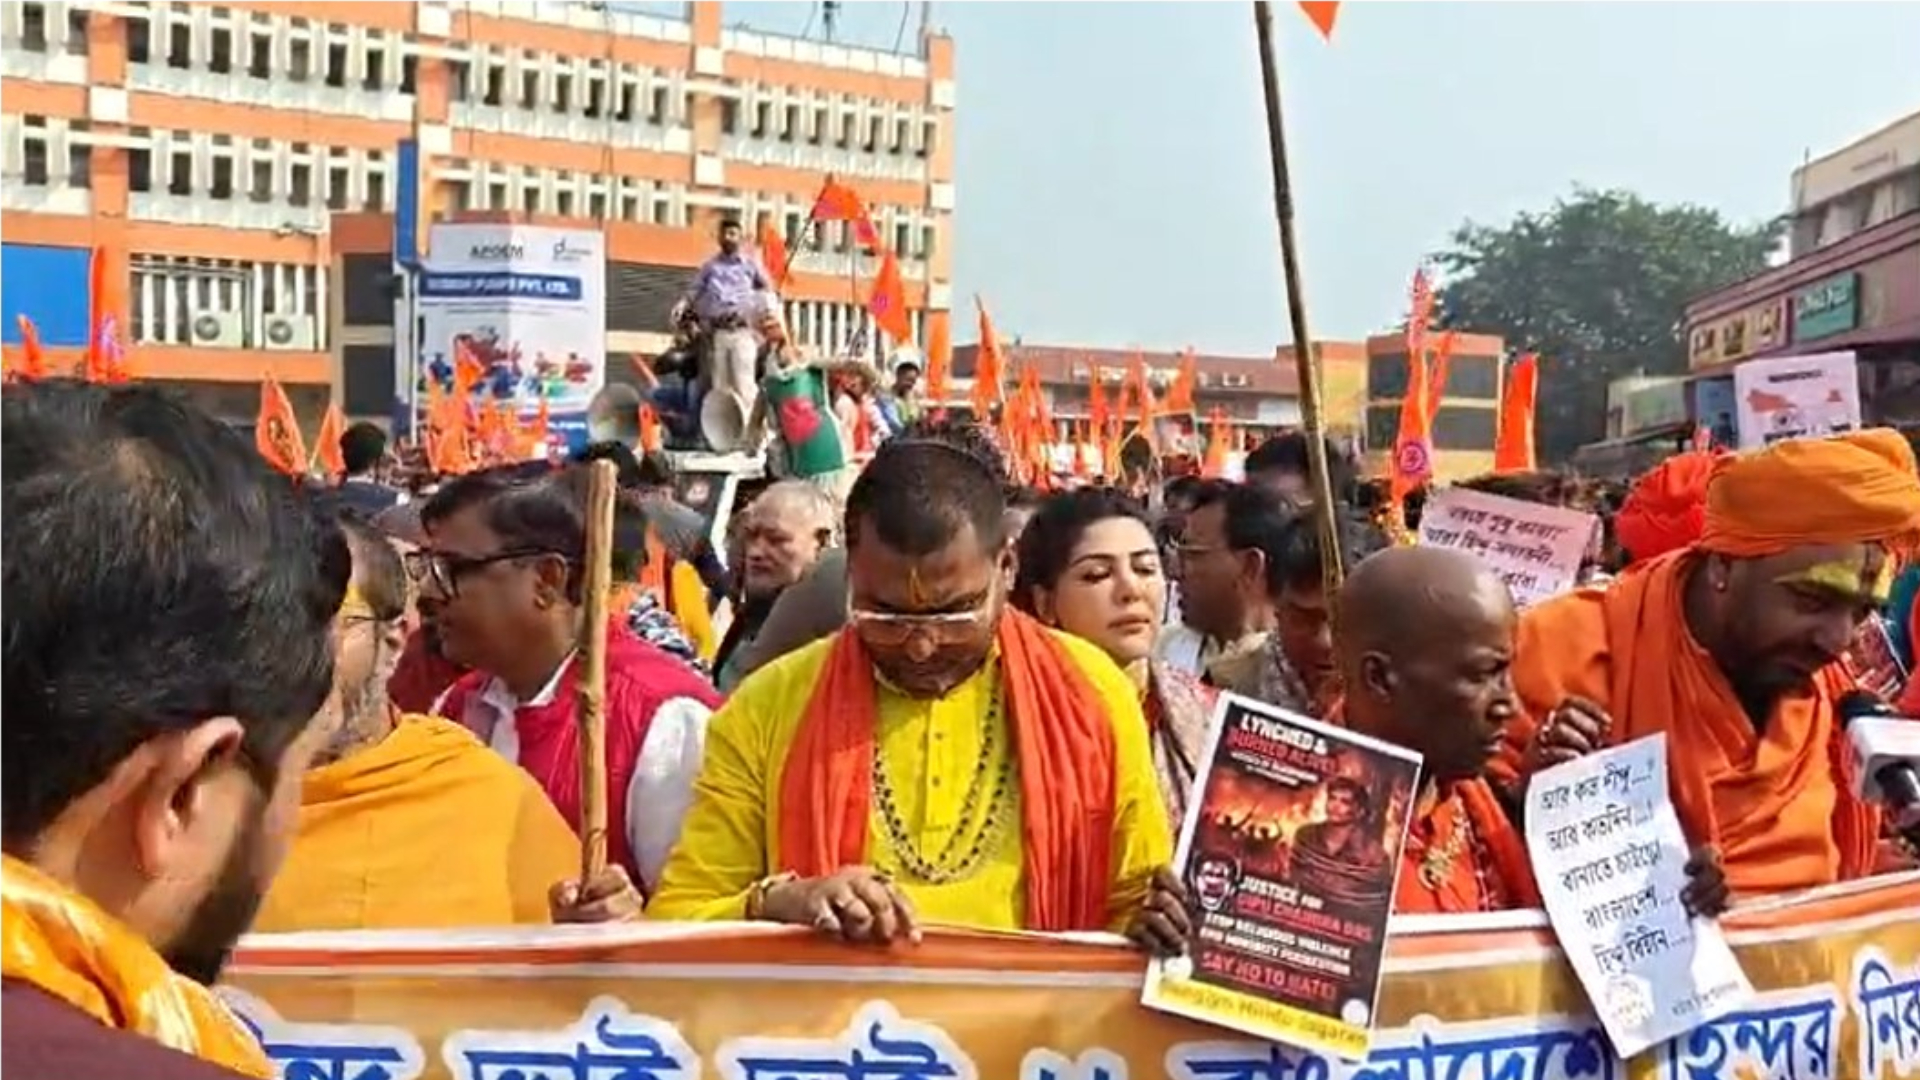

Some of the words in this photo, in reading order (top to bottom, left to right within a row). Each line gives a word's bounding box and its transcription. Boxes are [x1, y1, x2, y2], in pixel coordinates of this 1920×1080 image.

[1241, 713, 1314, 751] LYNCHED
[1313, 738, 1328, 756] &
[1239, 876, 1299, 906] JUSTICE
[1202, 951, 1233, 973] SAY
[1235, 957, 1262, 981] NO
[1264, 967, 1285, 986] TO
